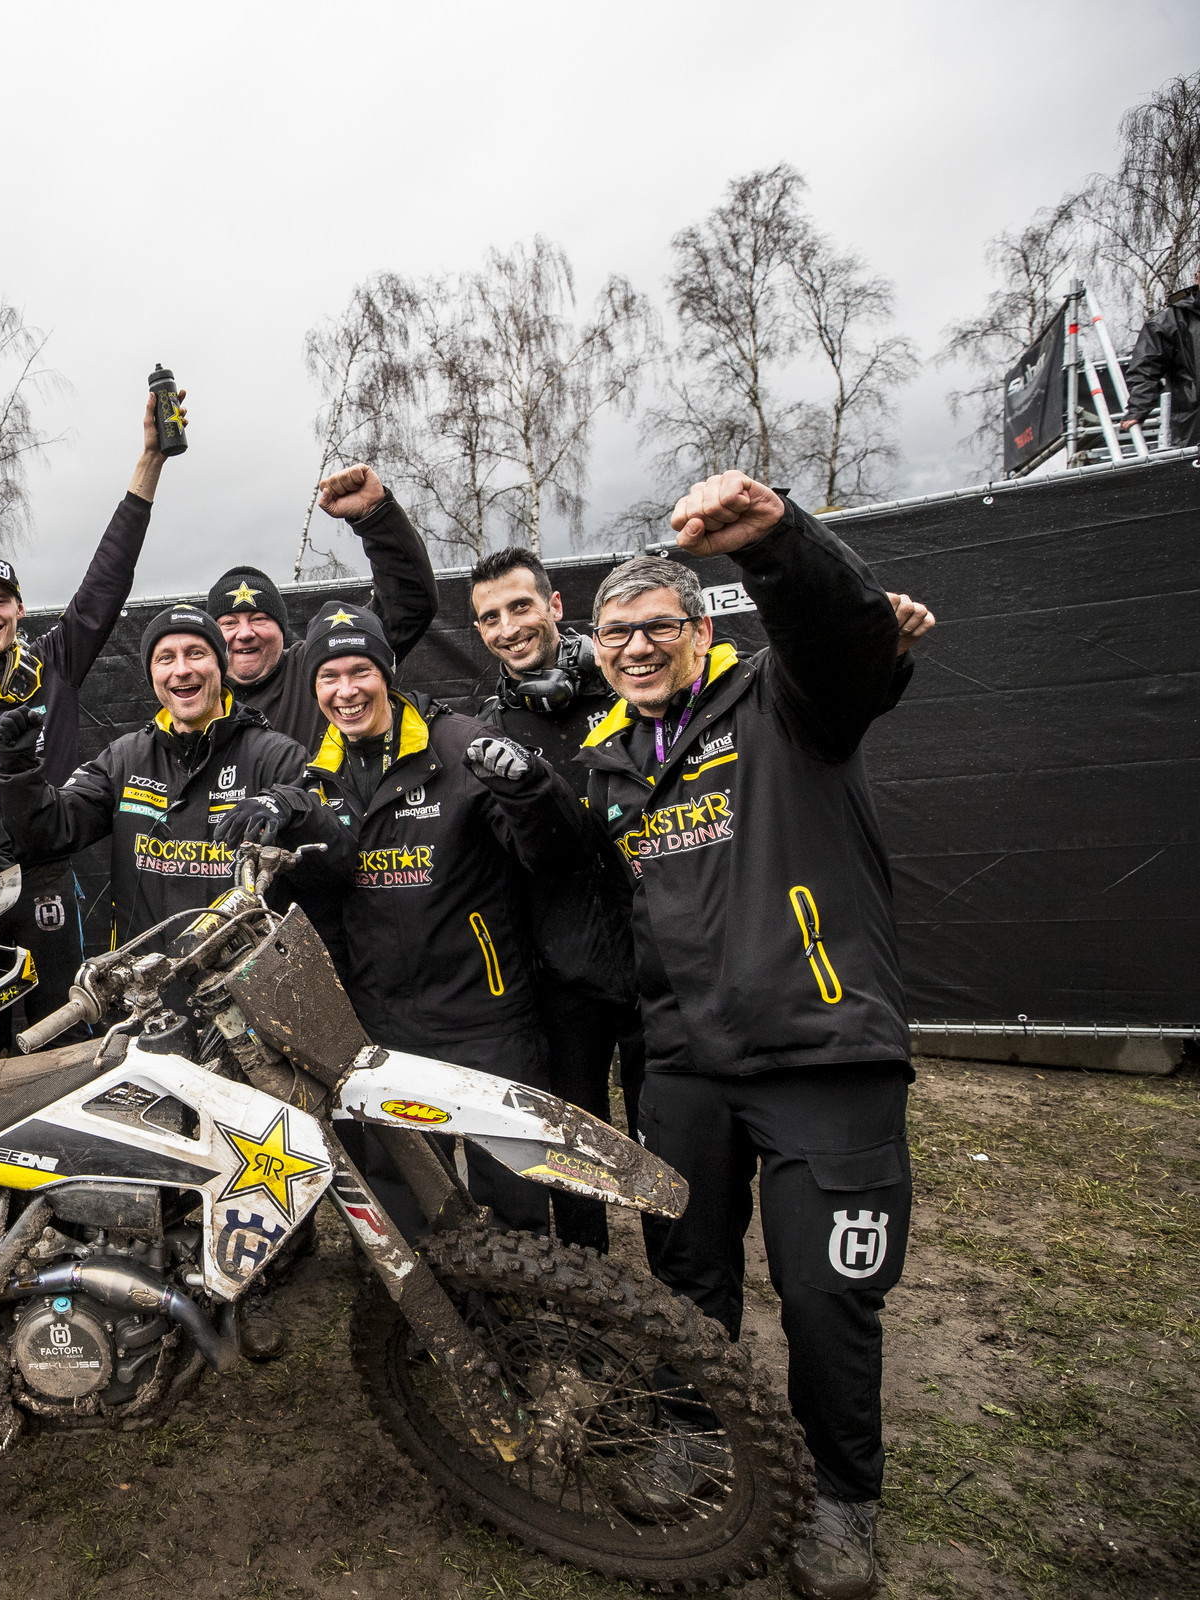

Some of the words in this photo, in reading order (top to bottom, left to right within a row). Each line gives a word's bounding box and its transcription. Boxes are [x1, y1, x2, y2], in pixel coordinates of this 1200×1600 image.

[133, 791, 165, 804] DUNLOP
[395, 802, 441, 819] Husqvarna
[667, 819, 732, 851] DRINK
[138, 854, 186, 873] ENERGY
[190, 862, 231, 875] DRINK
[356, 847, 432, 872] CKSTAR
[384, 869, 431, 885] DRINK
[383, 1103, 447, 1121] FMF
[40, 1346, 84, 1356] FACTORY
[29, 1361, 100, 1370] REKLUSE
